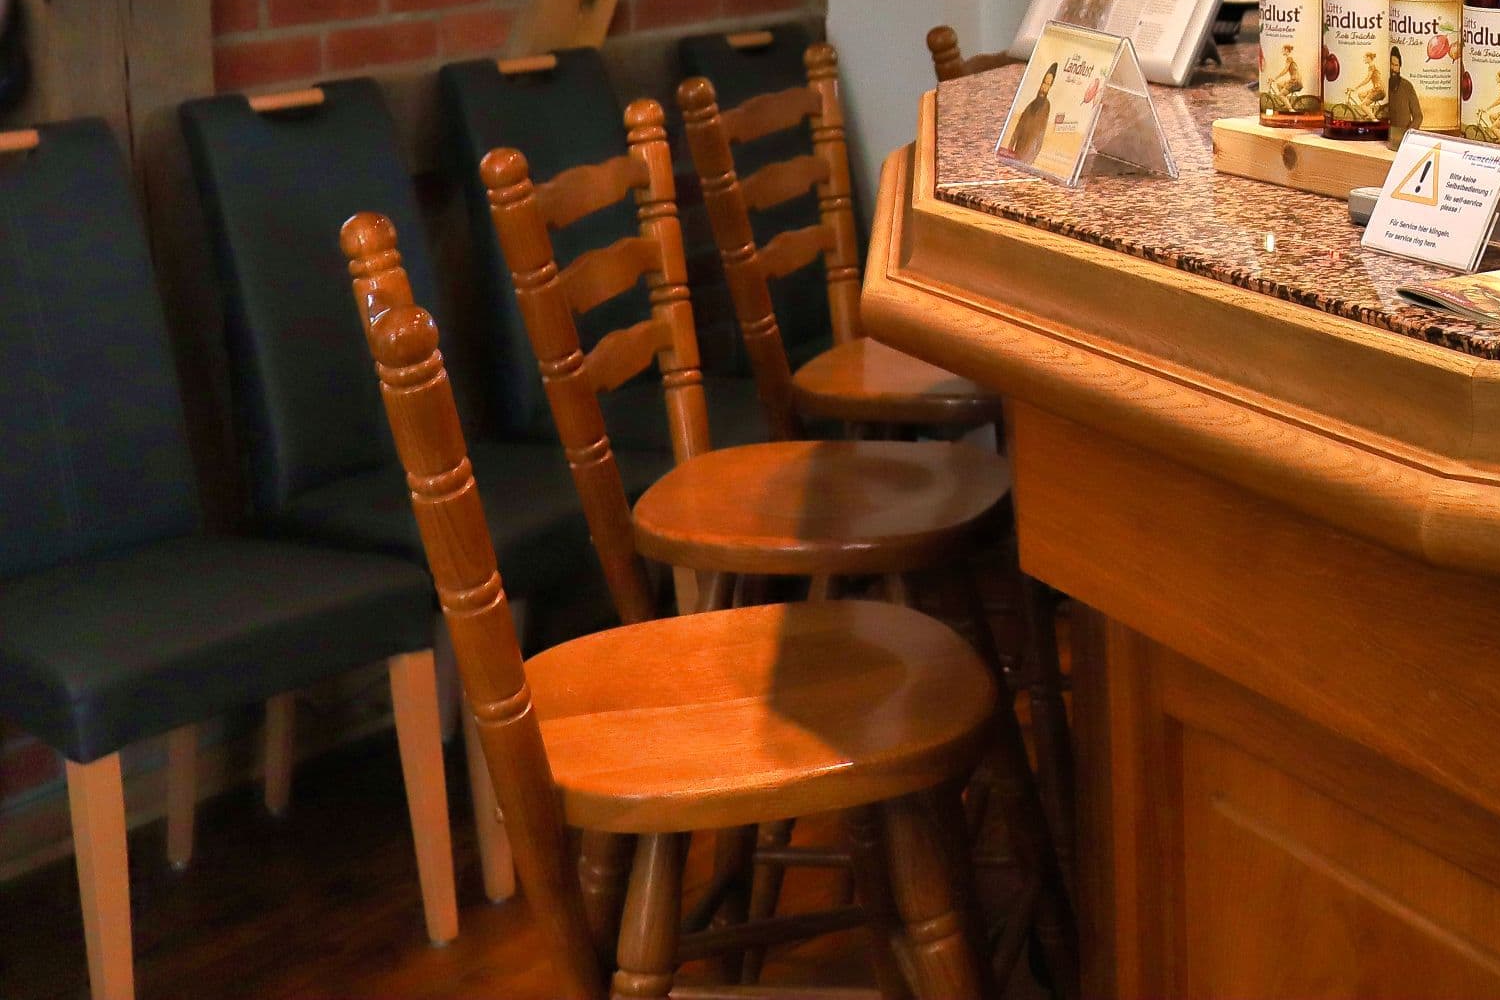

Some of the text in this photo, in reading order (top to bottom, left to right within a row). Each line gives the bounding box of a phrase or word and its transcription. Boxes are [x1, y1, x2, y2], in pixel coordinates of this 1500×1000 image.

[1260, 4, 1300, 22] ndlust
[1326, 11, 1383, 29] andlust
[1462, 175, 1477, 183] keine
[1439, 203, 1458, 212] please
[1389, 218, 1399, 226] Für
[1399, 221, 1417, 230] Service
[1418, 224, 1429, 233] hier
[1394, 234, 1413, 243] service
